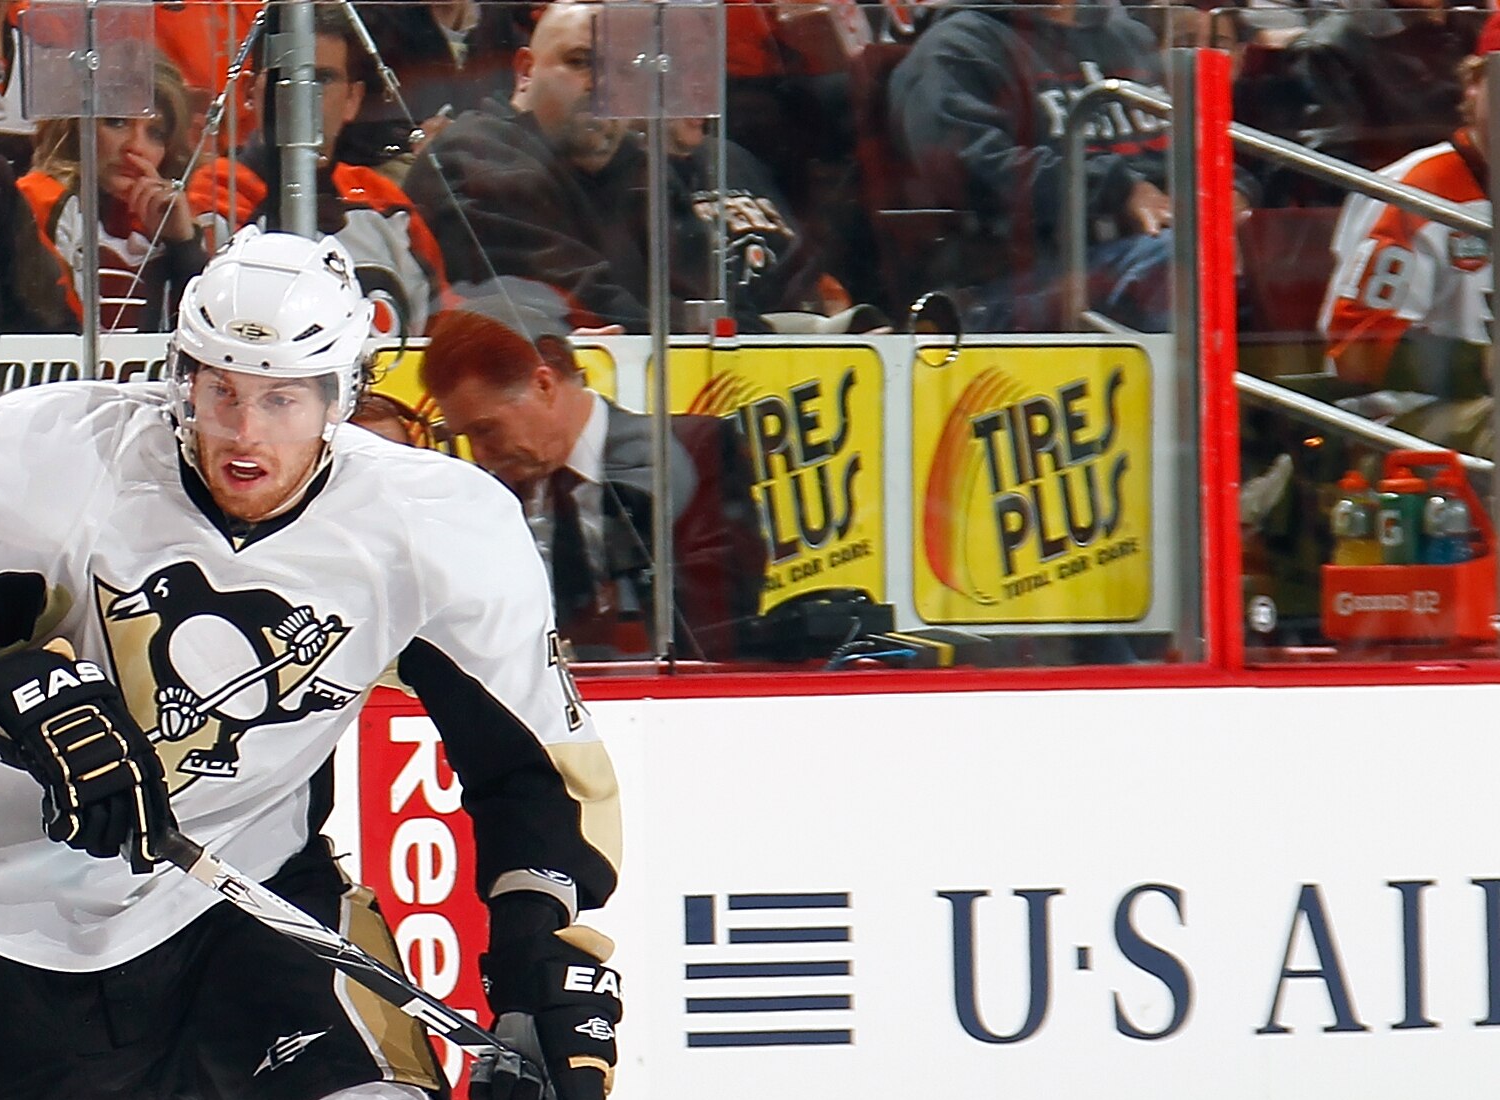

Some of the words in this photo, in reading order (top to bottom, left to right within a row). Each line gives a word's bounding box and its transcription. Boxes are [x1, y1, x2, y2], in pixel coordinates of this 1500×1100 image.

[970, 365, 1125, 496] TIRES
[760, 451, 862, 565] LUS
[994, 452, 1130, 577] PLUS
[11, 661, 106, 714] EAS
[563, 965, 624, 999] EA
